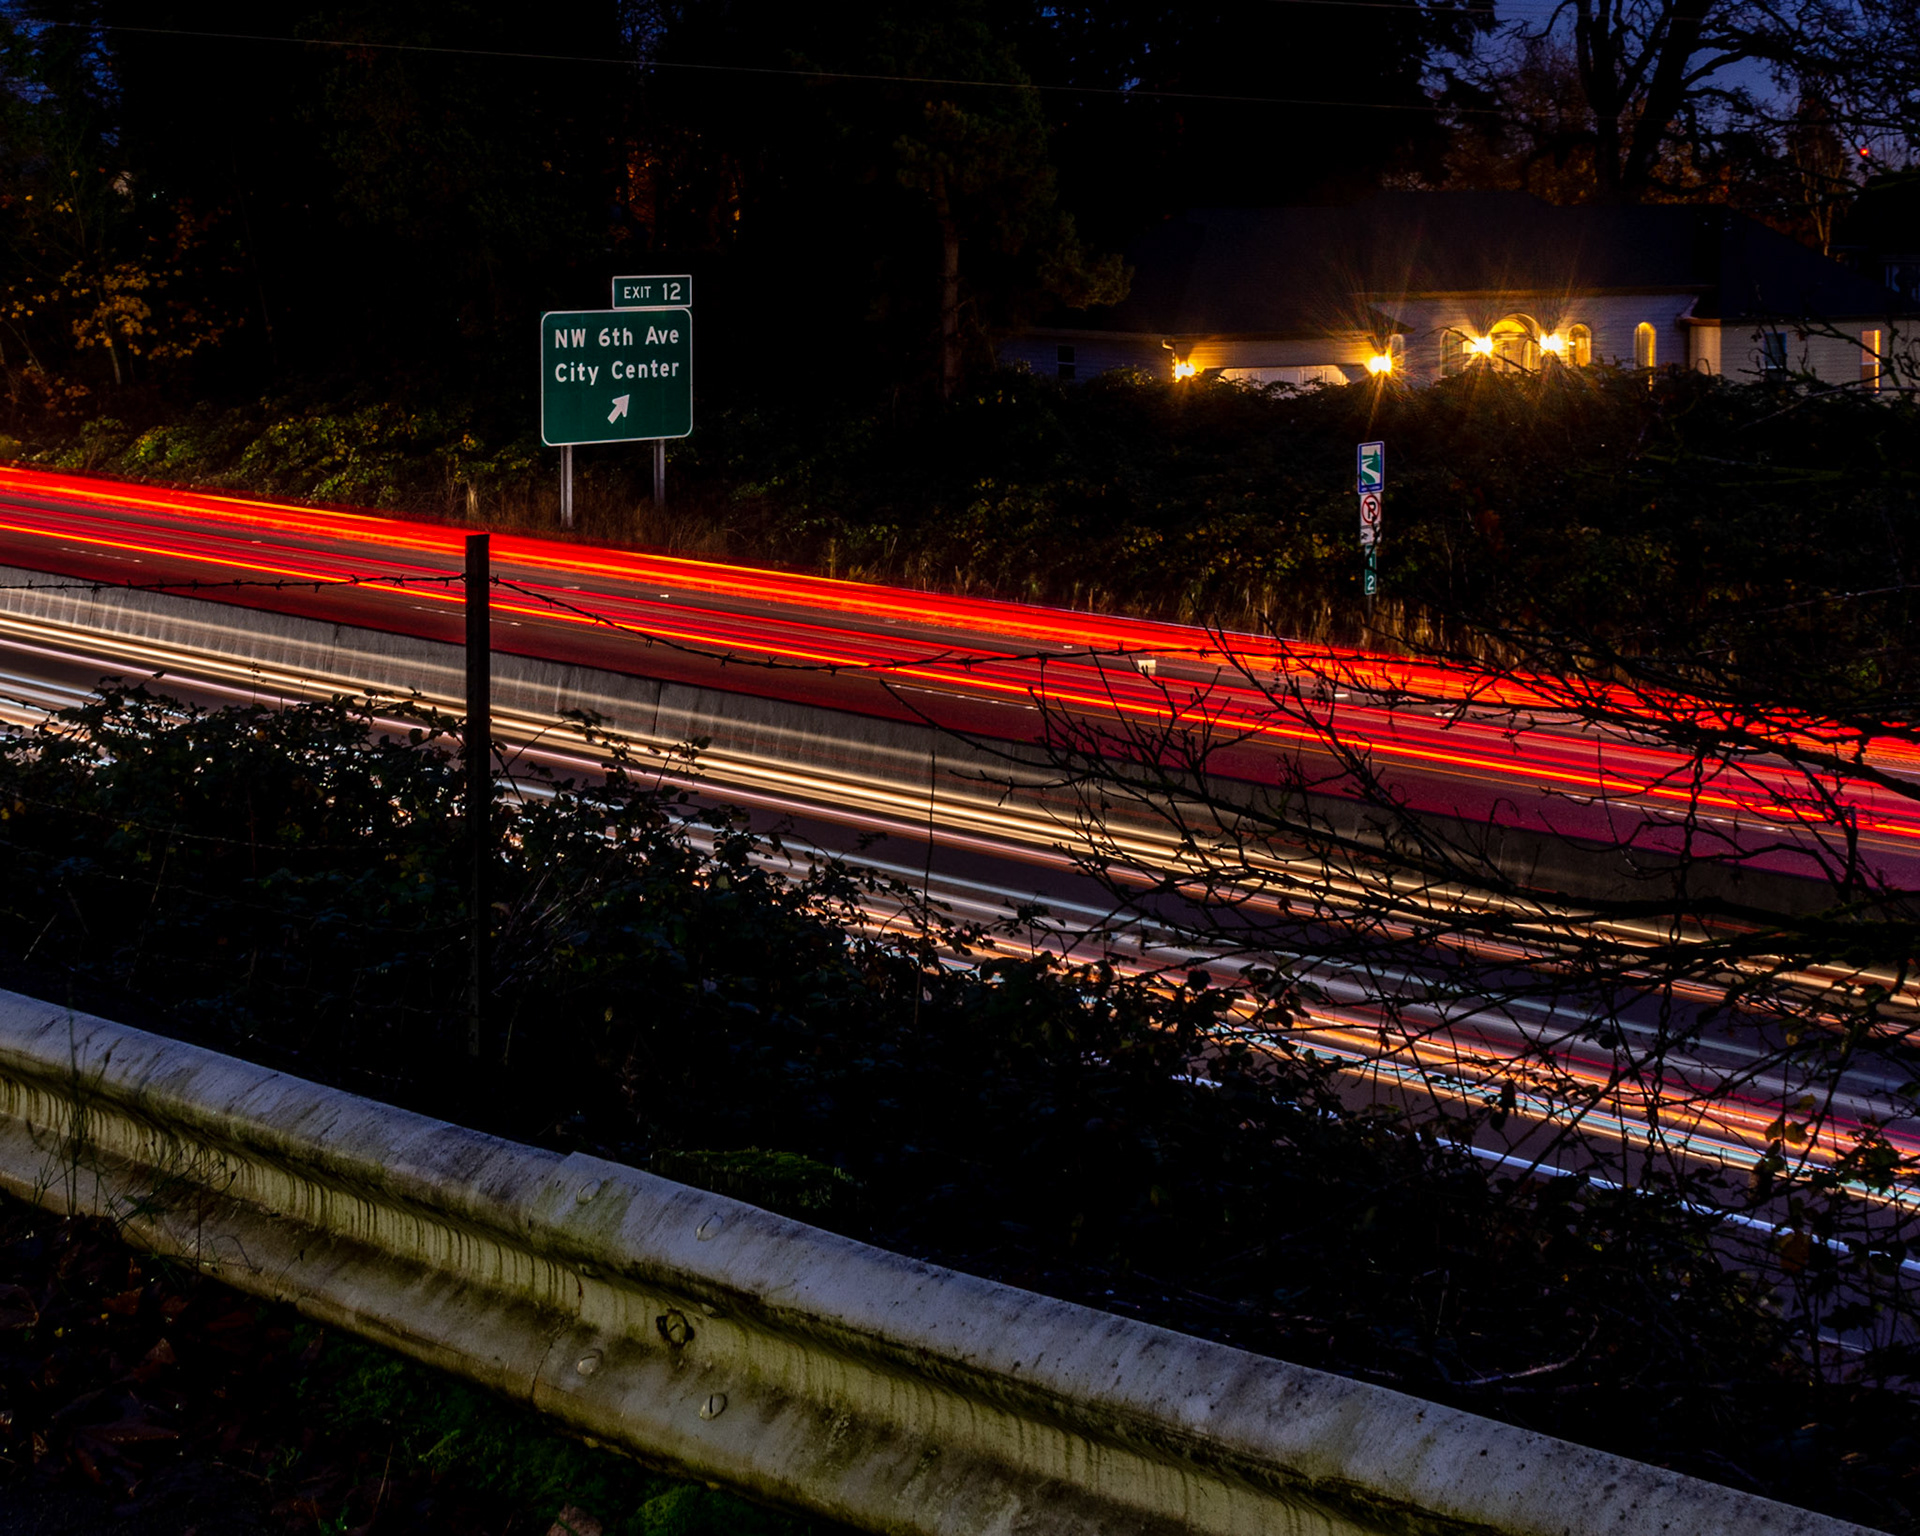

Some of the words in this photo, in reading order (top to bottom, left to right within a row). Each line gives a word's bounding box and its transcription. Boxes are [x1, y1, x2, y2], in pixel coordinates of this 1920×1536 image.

[624, 286, 651, 299] EXIT
[663, 282, 681, 301] 12
[555, 328, 586, 348] NW
[598, 327, 633, 347] 6th
[645, 326, 679, 345] Ave
[555, 362, 599, 386] City
[611, 359, 679, 380] Center
